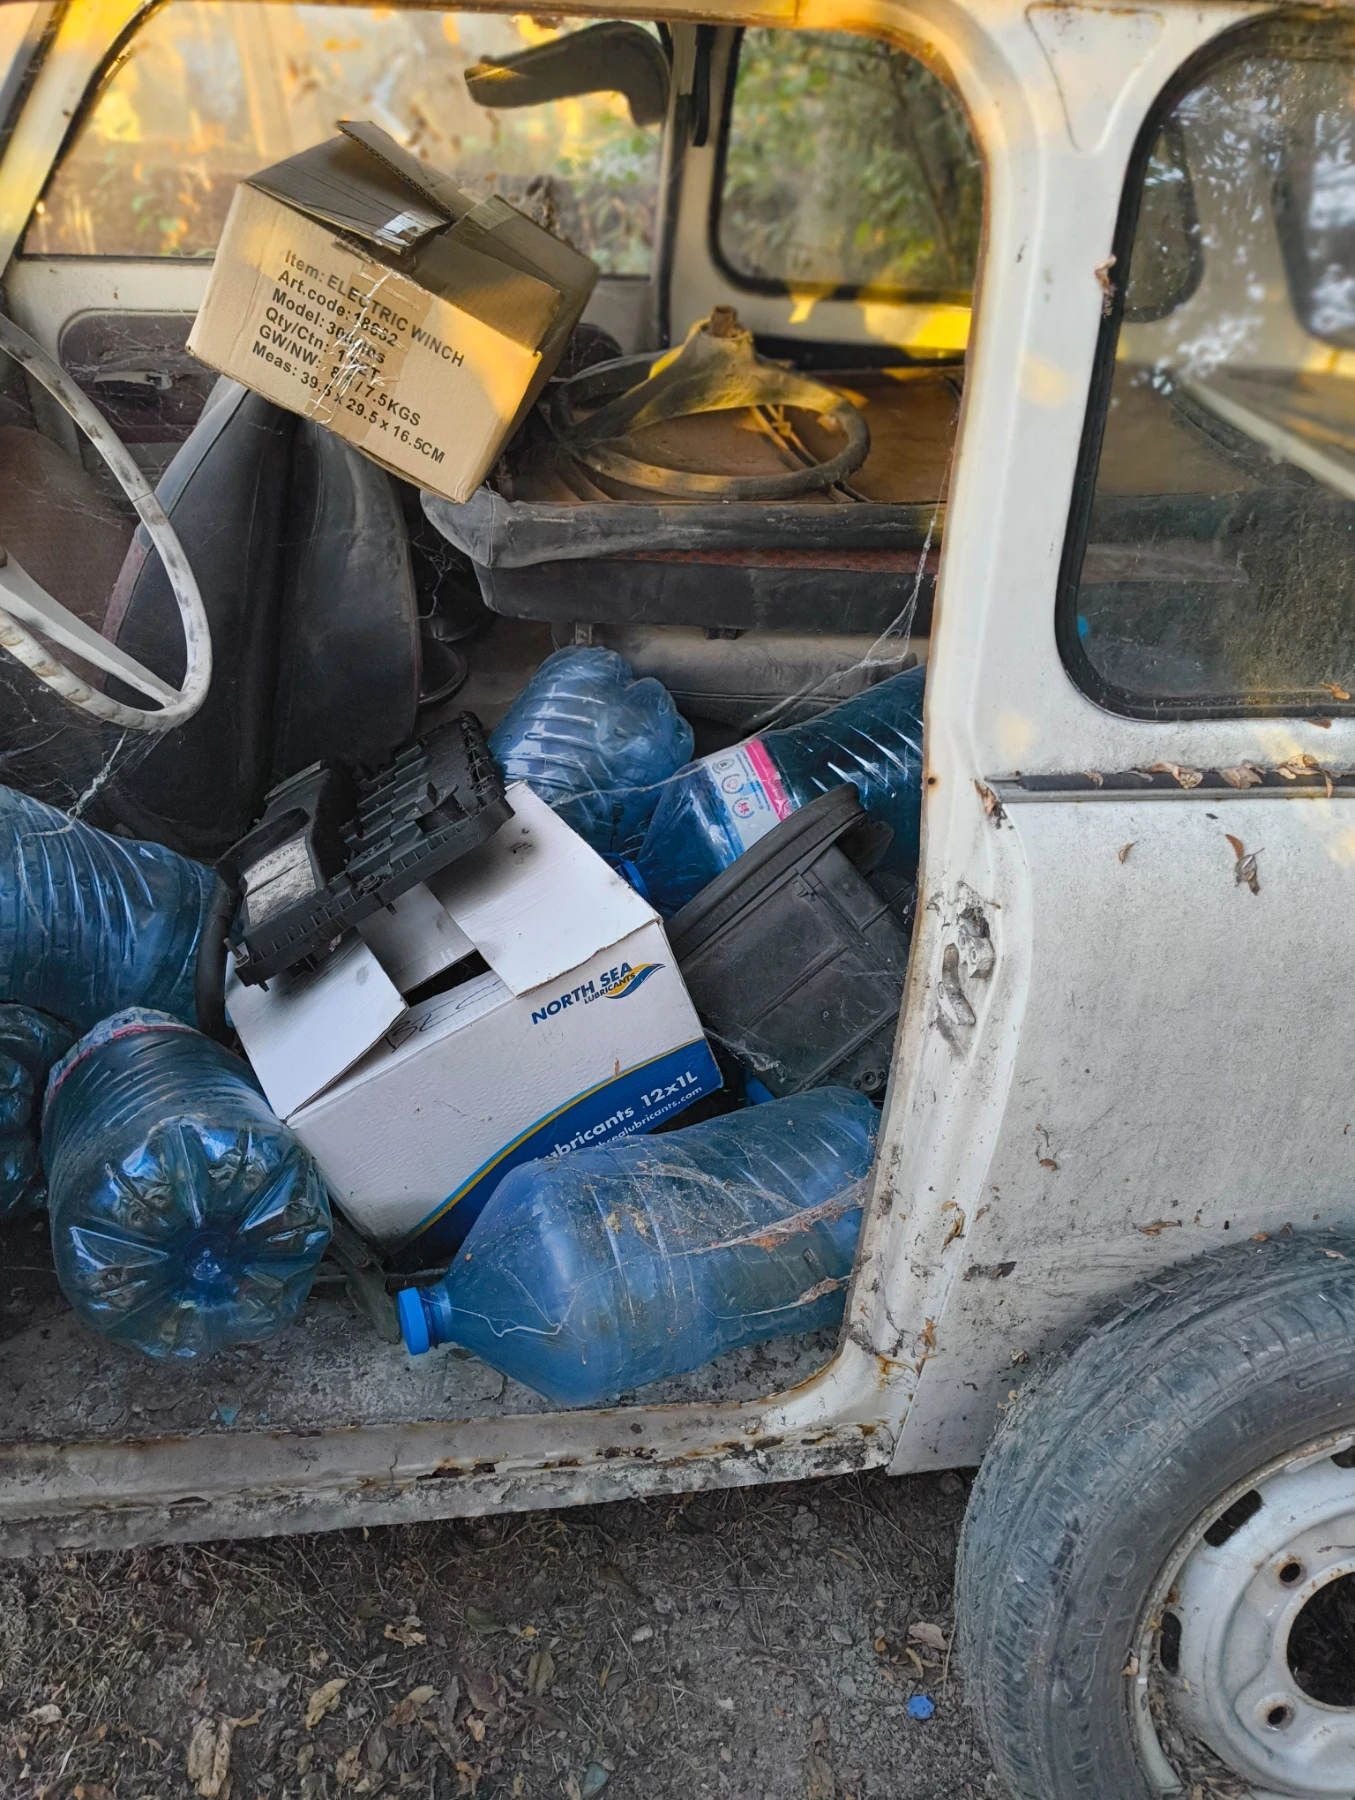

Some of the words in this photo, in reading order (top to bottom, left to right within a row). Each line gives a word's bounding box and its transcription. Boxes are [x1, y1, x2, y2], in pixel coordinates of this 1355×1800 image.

[266, 307, 329, 352] Qty/Ctn:
[338, 349, 346, 362] 1
[272, 288, 325, 327] Model:
[285, 250, 325, 282] Item:
[327, 274, 408, 331] ELECTRIC
[411, 324, 465, 367] WINCH
[252, 340, 297, 376] Meas:
[300, 371, 332, 396] 39.5
[346, 398, 379, 424] 29.5
[393, 426, 446, 464] 16.5CM
[260, 325, 321, 368] GW/NW:
[365, 385, 421, 426] 7.5KGS
[531, 981, 595, 1025] NORTH
[599, 962, 633, 988] SEA
[583, 972, 636, 1004] LUBRICANTS
[534, 1106, 635, 1160] bricants
[641, 1070, 698, 1107] 12x1L
